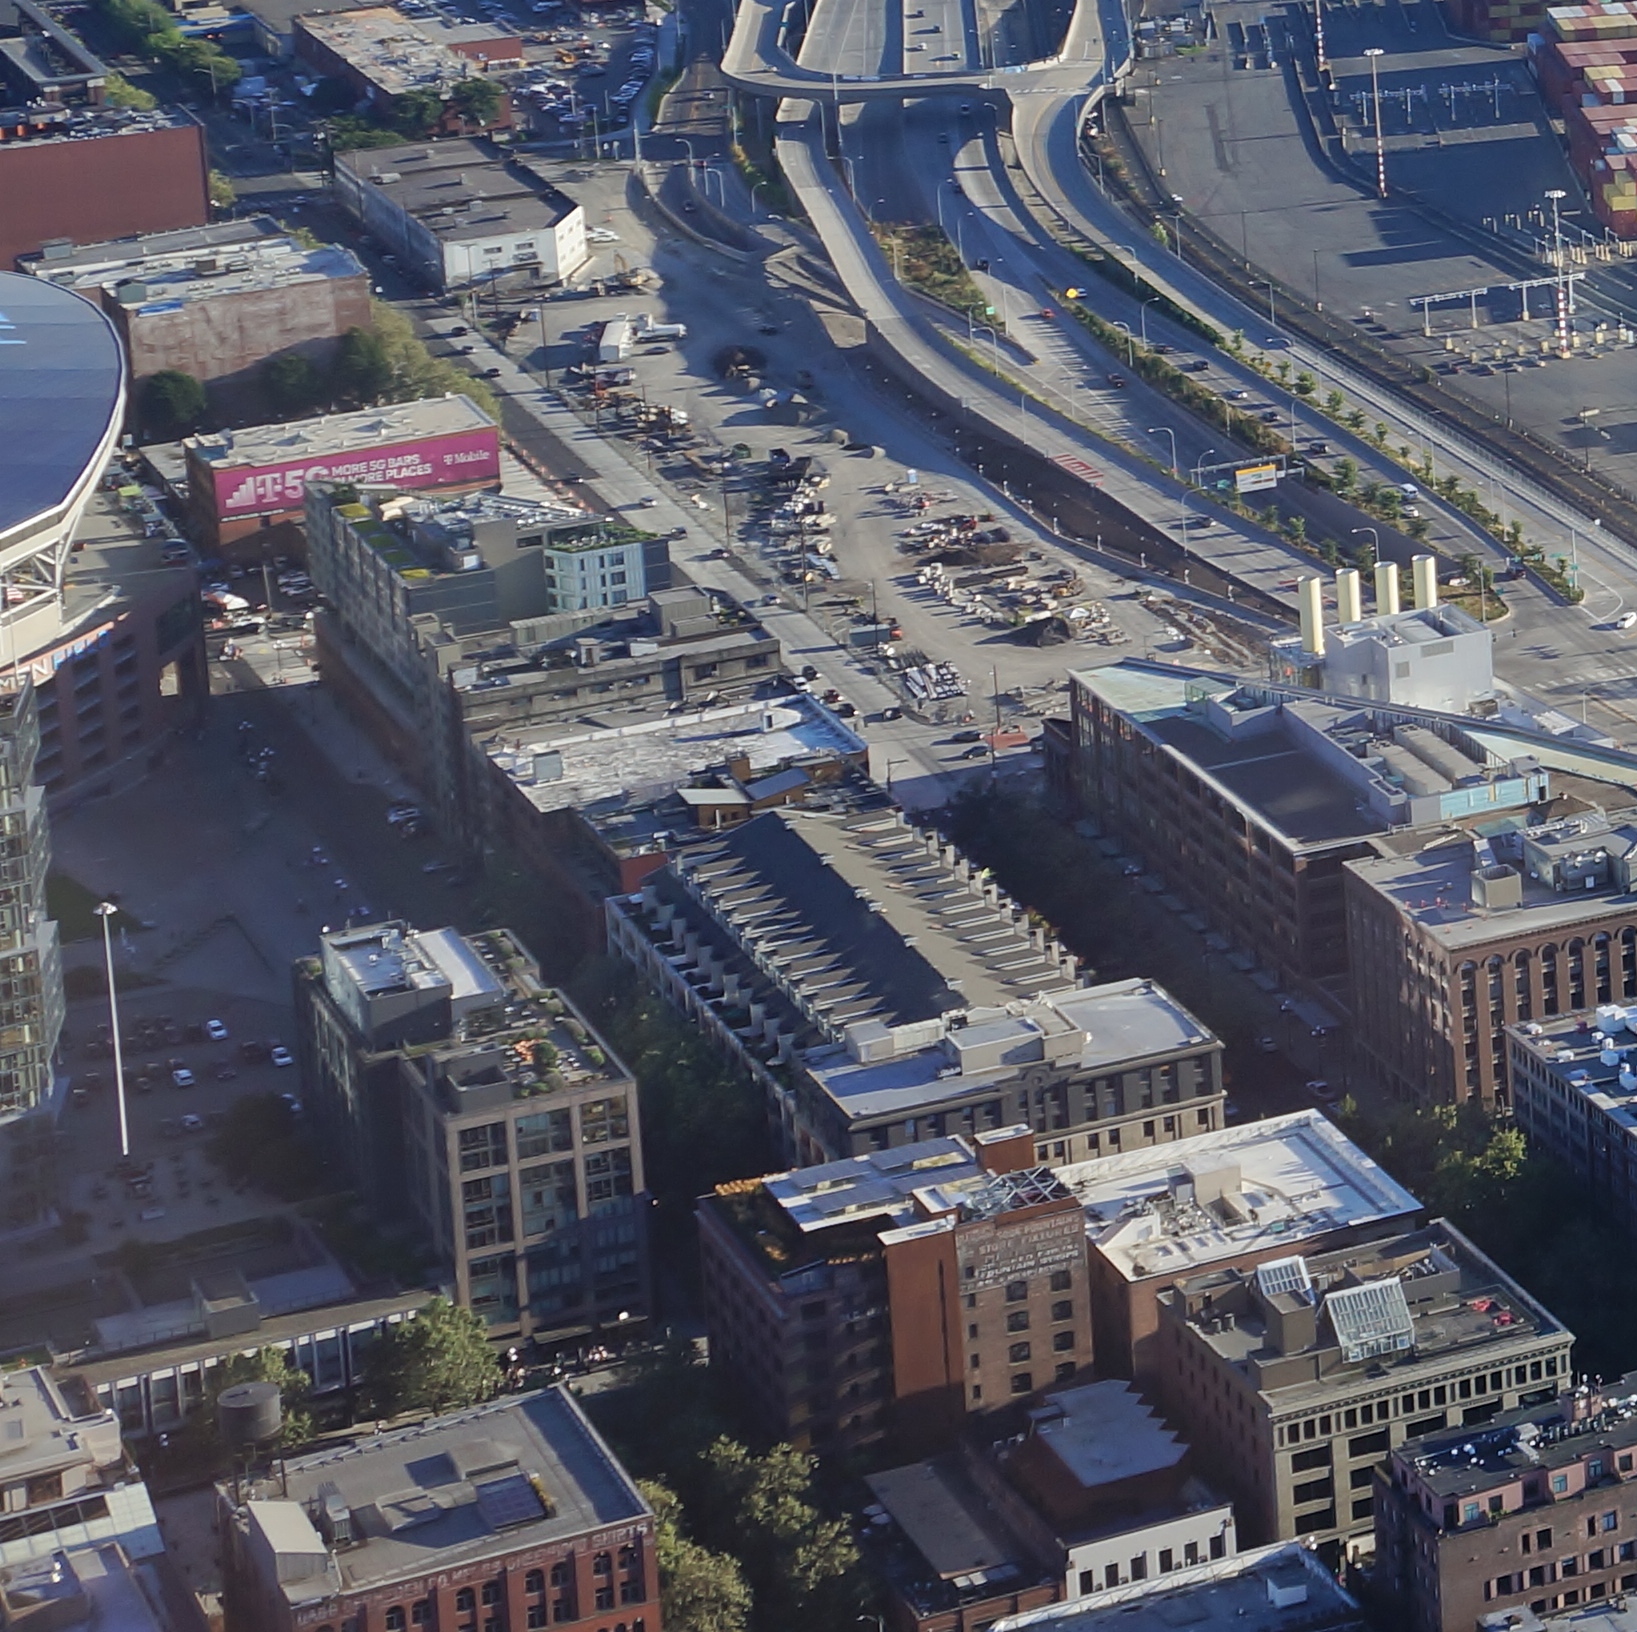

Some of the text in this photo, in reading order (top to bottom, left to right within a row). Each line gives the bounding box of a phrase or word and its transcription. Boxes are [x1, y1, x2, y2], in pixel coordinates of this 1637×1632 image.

[331, 454, 420, 476] MORE 5G BARS
[454, 450, 490, 464] Mobile
[385, 463, 432, 481] PLACES
[592, 1522, 648, 1549] SHIRTS
